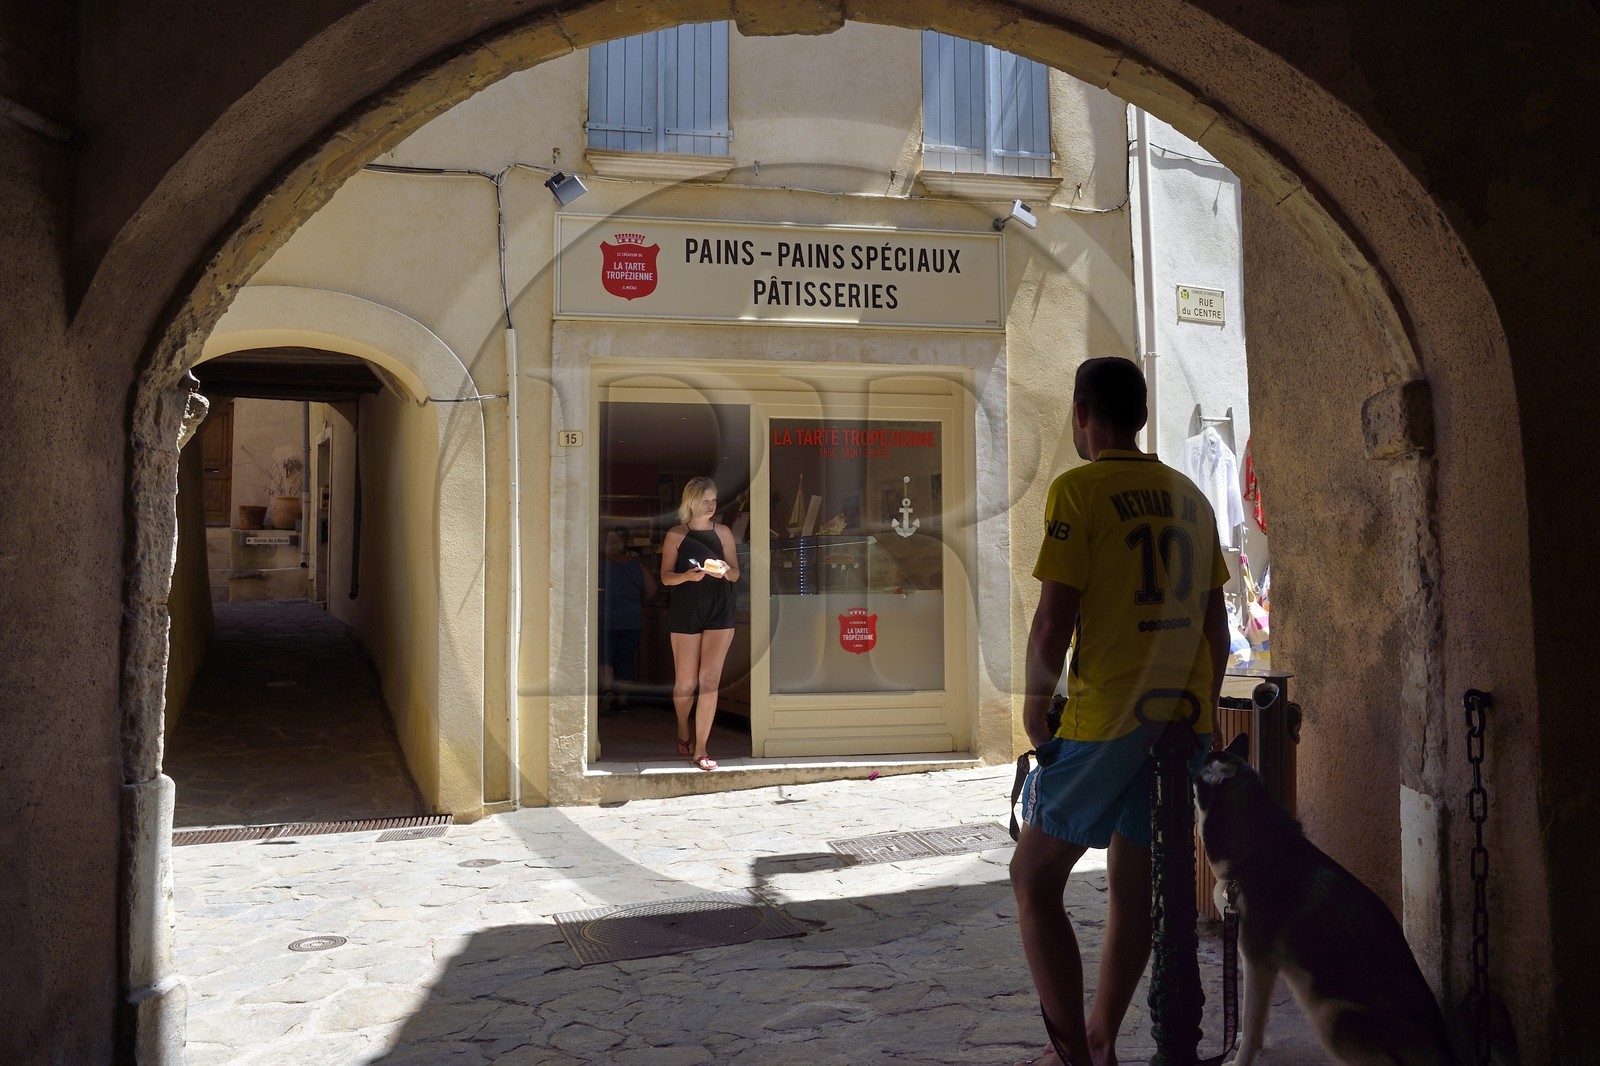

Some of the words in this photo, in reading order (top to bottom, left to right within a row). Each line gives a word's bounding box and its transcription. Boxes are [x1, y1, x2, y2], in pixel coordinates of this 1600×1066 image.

[685, 238, 755, 266] PAINS
[778, 242, 845, 269] PAINS
[850, 241, 961, 275] SPÉCIAUX
[613, 261, 623, 270] LA
[624, 262, 646, 271] TARTE
[606, 269, 653, 281] TROPÉZIENNE
[753, 276, 899, 310] PÂTISSERIES
[1198, 297, 1214, 308] RUE
[1181, 307, 1191, 315] du
[1193, 308, 1222, 319] CENTRE
[565, 433, 577, 444] 15
[773, 428, 793, 446] LA
[796, 429, 839, 446] TARTE
[843, 429, 937, 448] TROPEZIENNE
[841, 448, 862, 459] SAINT
[1110, 489, 1175, 523] NEYMAR
[1182, 495, 1199, 526] JR
[1125, 523, 1194, 606] 10
